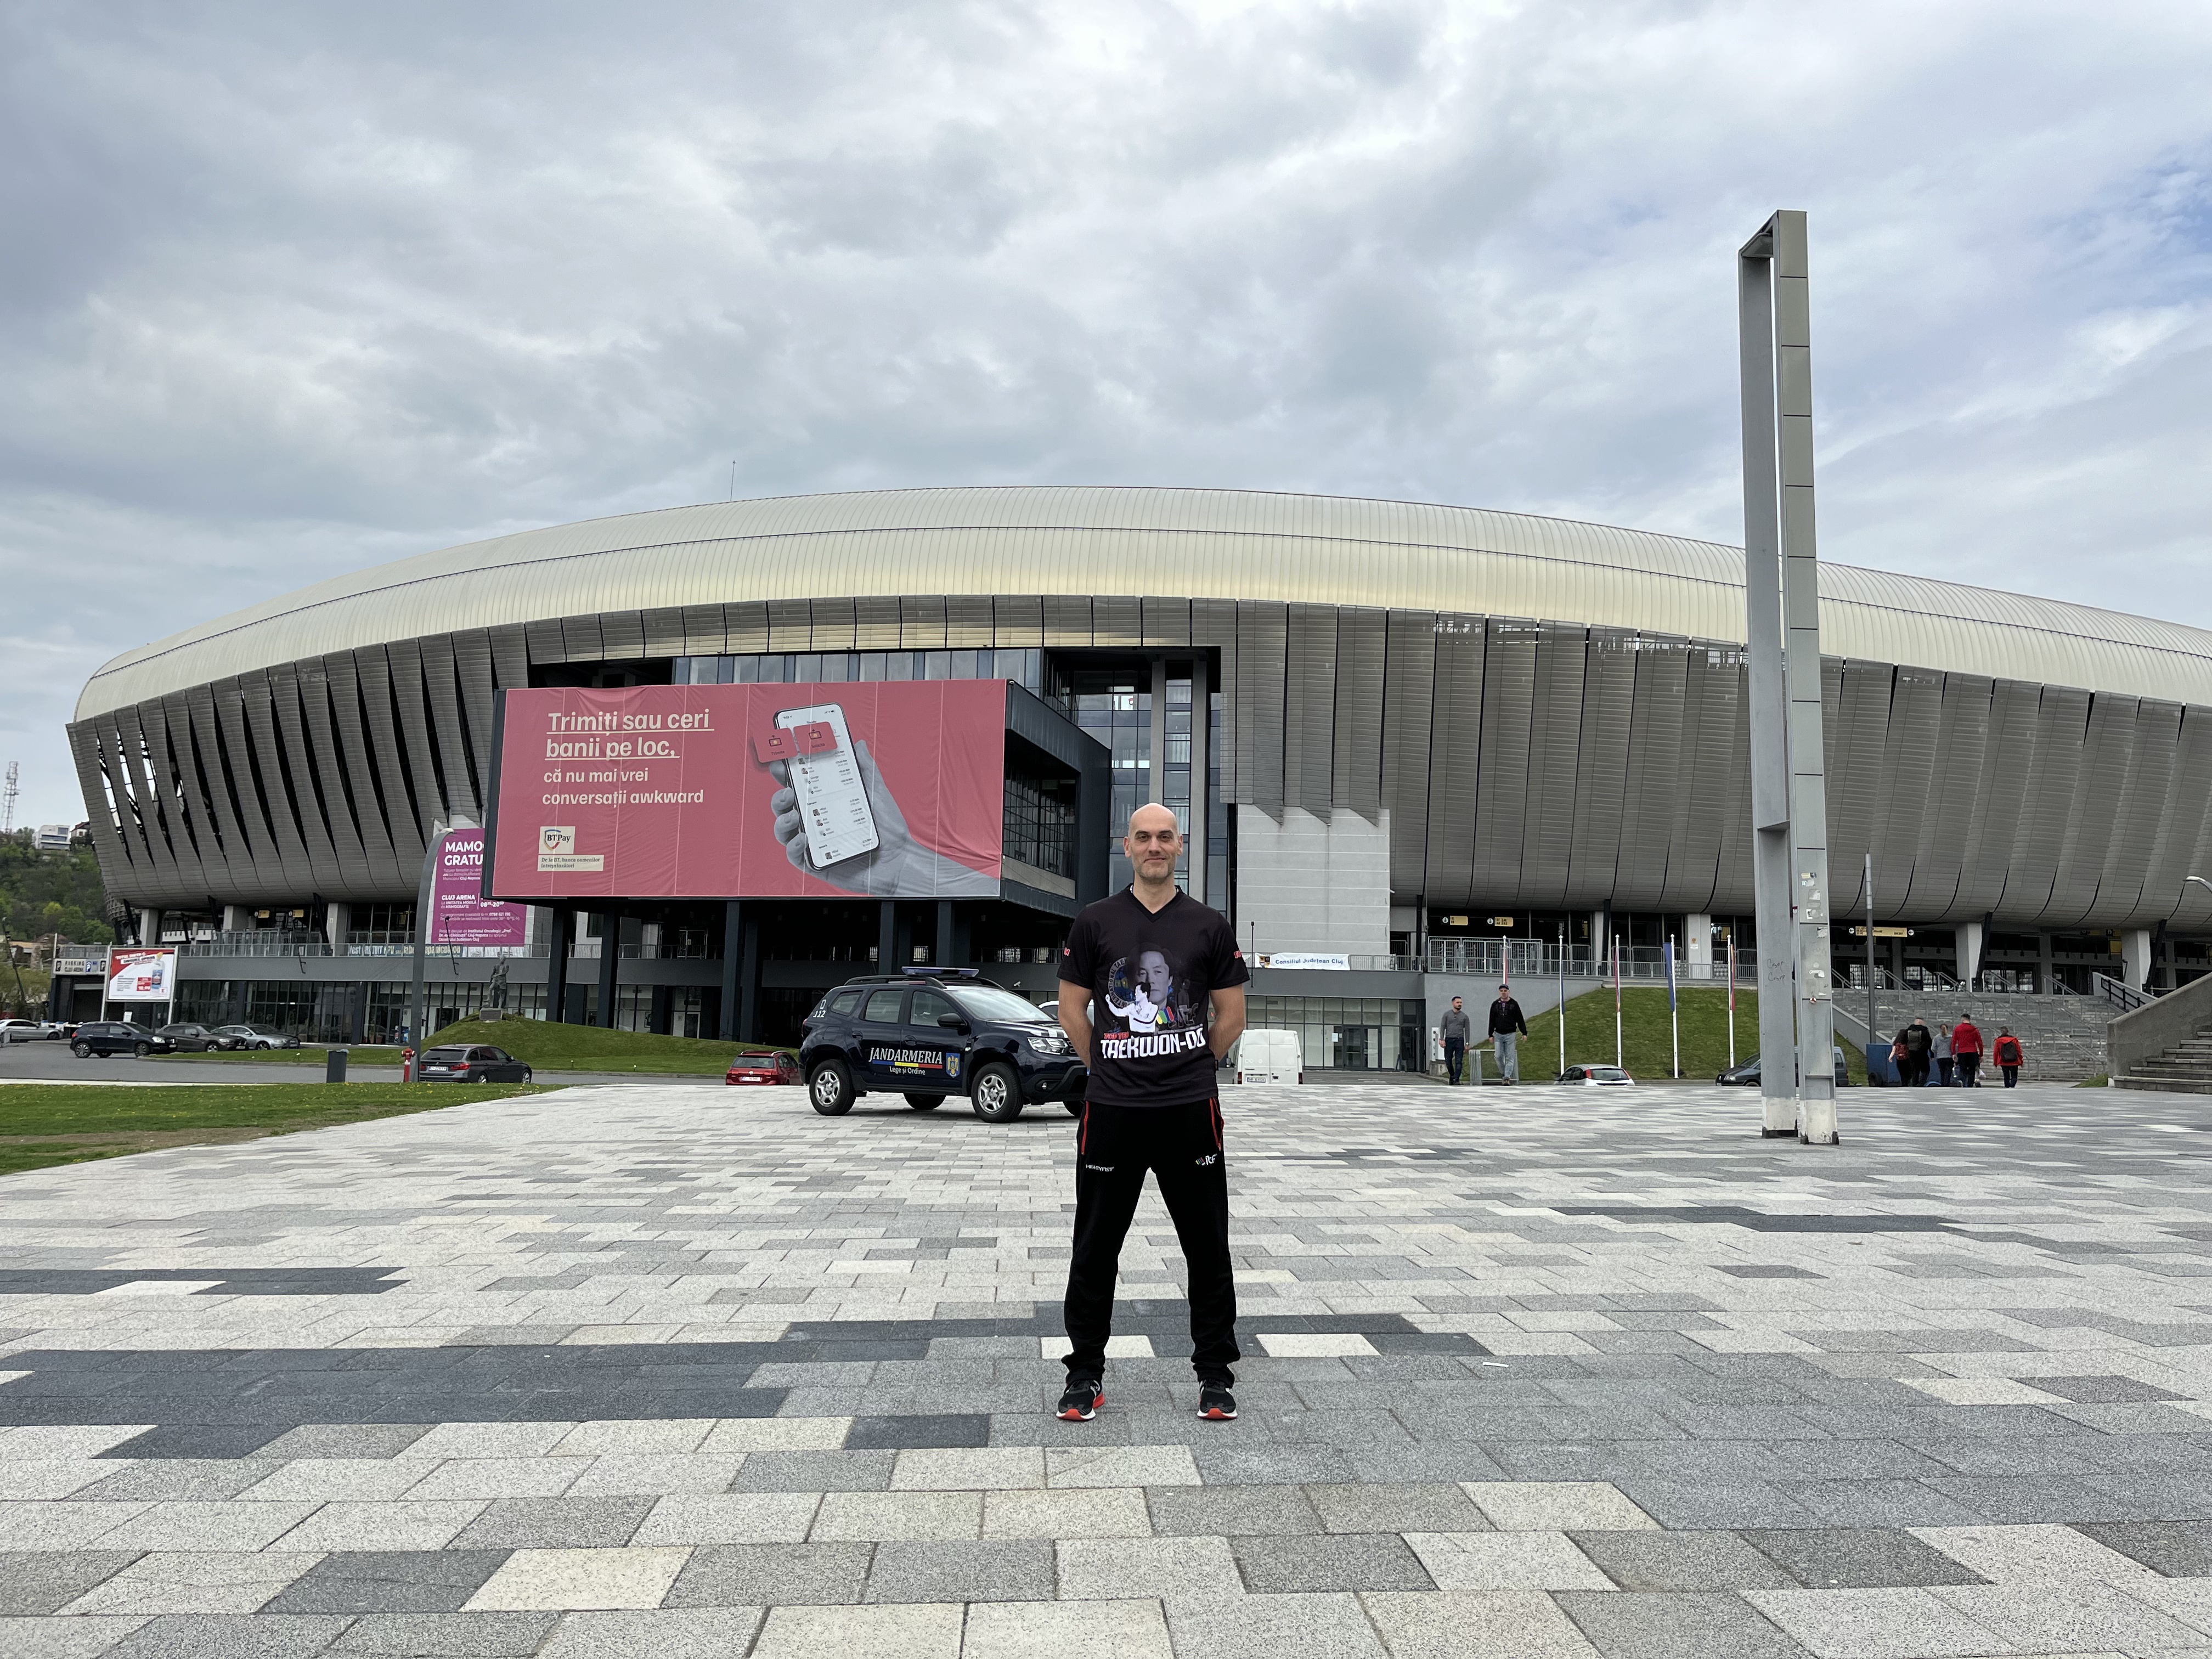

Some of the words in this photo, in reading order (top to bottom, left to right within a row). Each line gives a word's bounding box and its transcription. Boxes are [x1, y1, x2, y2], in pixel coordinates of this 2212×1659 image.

[548, 711, 618, 736] Trimiți
[623, 714, 662, 730] sau
[667, 708, 709, 729] ceri
[546, 737, 600, 758] banii
[606, 741, 631, 760] pe
[637, 737, 675, 758] loc,
[544, 769, 561, 783] că
[566, 772, 585, 782] nu
[589, 768, 617, 782] mai
[621, 768, 648, 782] vrei
[542, 790, 627, 808] conversații
[630, 789, 703, 804] awkward
[445, 840, 484, 853] MAMO
[1100, 1027, 1206, 1059] TAEKWON-DO
[868, 1047, 943, 1064] JANDARMERIA
[889, 1066, 901, 1074] Lege
[902, 1067, 907, 1075] și
[907, 1067, 926, 1075] Ordine
